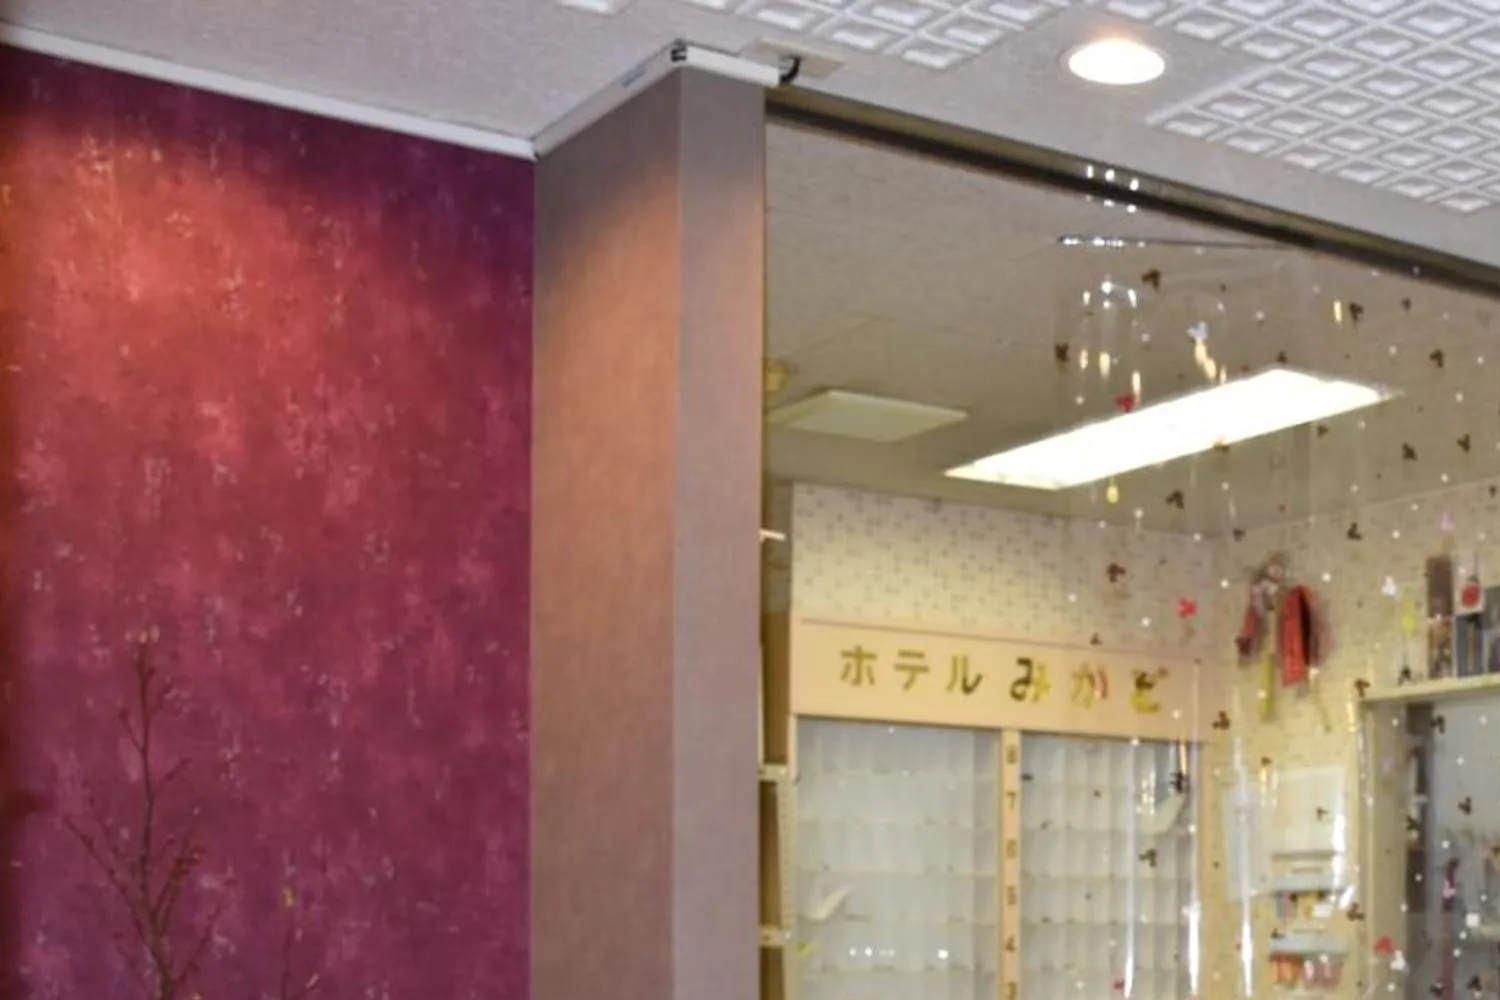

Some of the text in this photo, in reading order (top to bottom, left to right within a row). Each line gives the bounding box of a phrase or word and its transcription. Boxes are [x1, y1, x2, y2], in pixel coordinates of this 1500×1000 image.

[839, 644, 1169, 714] ホテルみかど
